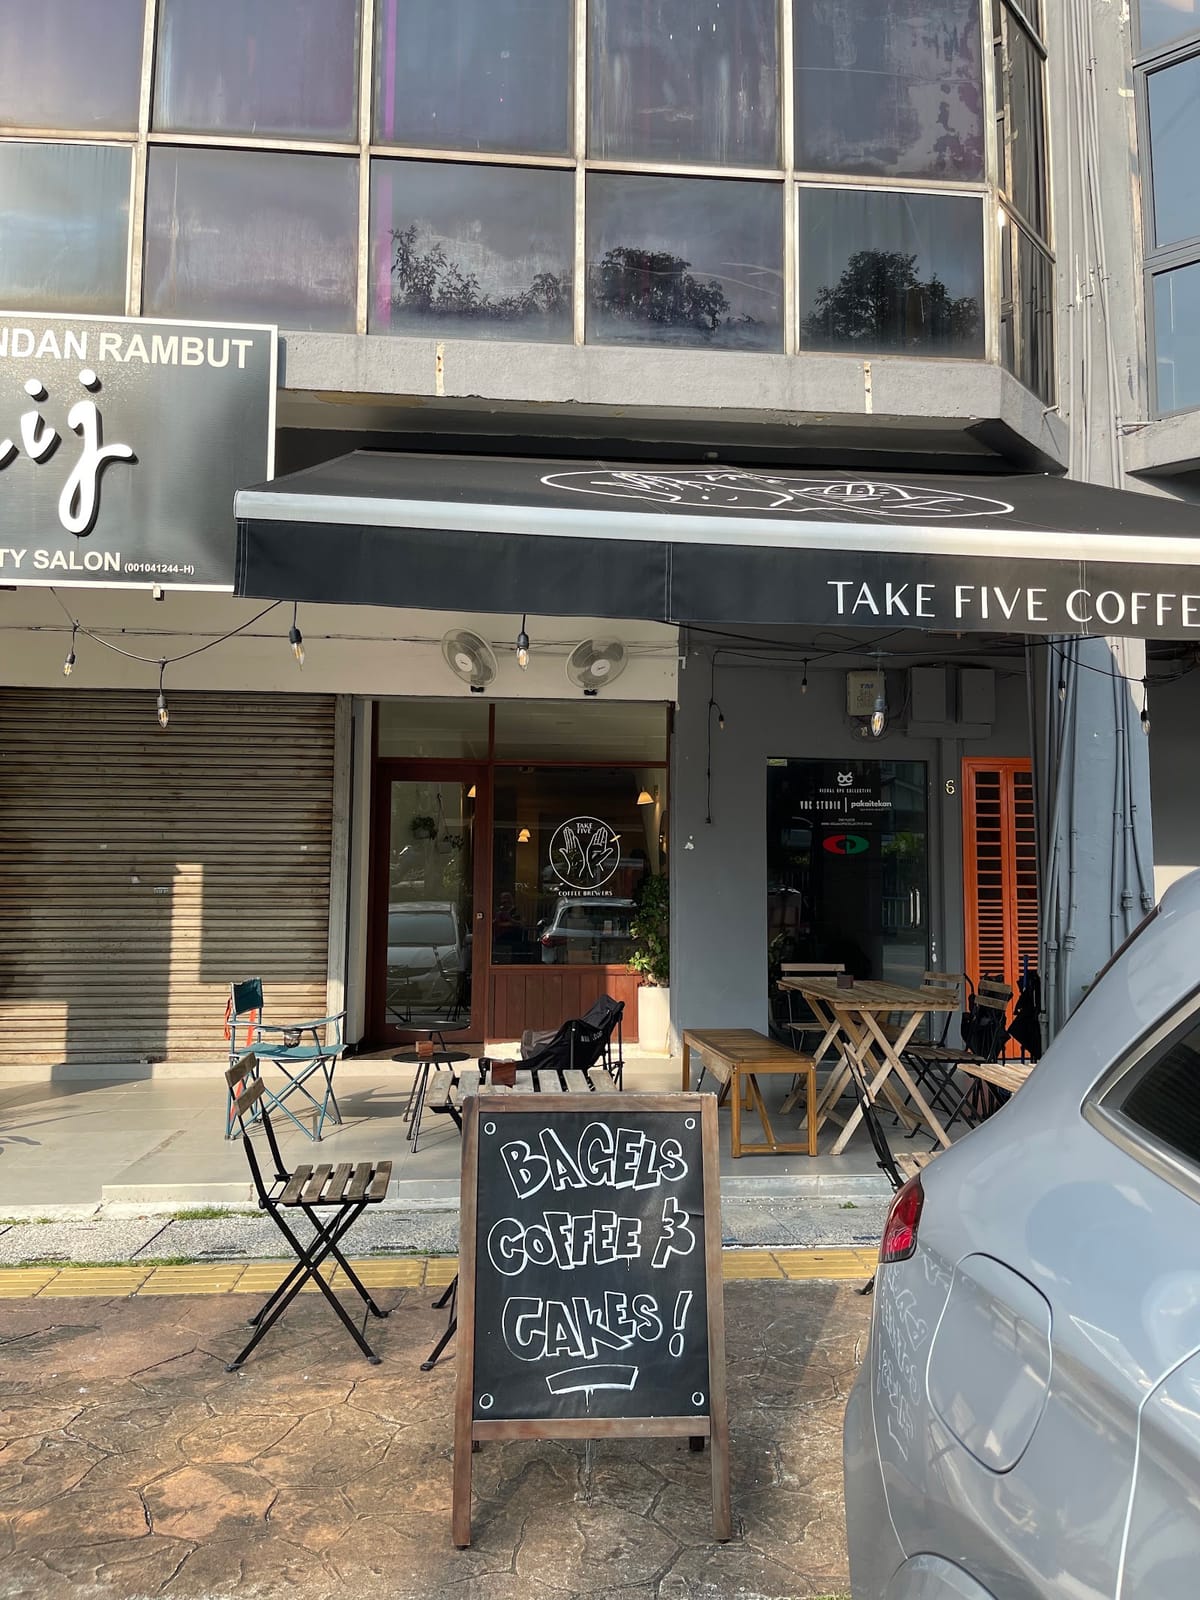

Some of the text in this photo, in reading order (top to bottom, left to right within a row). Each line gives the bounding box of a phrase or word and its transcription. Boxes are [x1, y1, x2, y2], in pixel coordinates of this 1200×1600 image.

[100, 333, 253, 369] RAMBUT
[33, 549, 121, 571] SALON
[124, 563, 195, 575] (001041244-H)
[827, 581, 1200, 628] TAKE FIVE COFFE
[816, 800, 841, 810] STUDIO
[945, 779, 955, 795] 6
[500, 1122, 688, 1199] BAGELS
[488, 1210, 642, 1276] COFFEE
